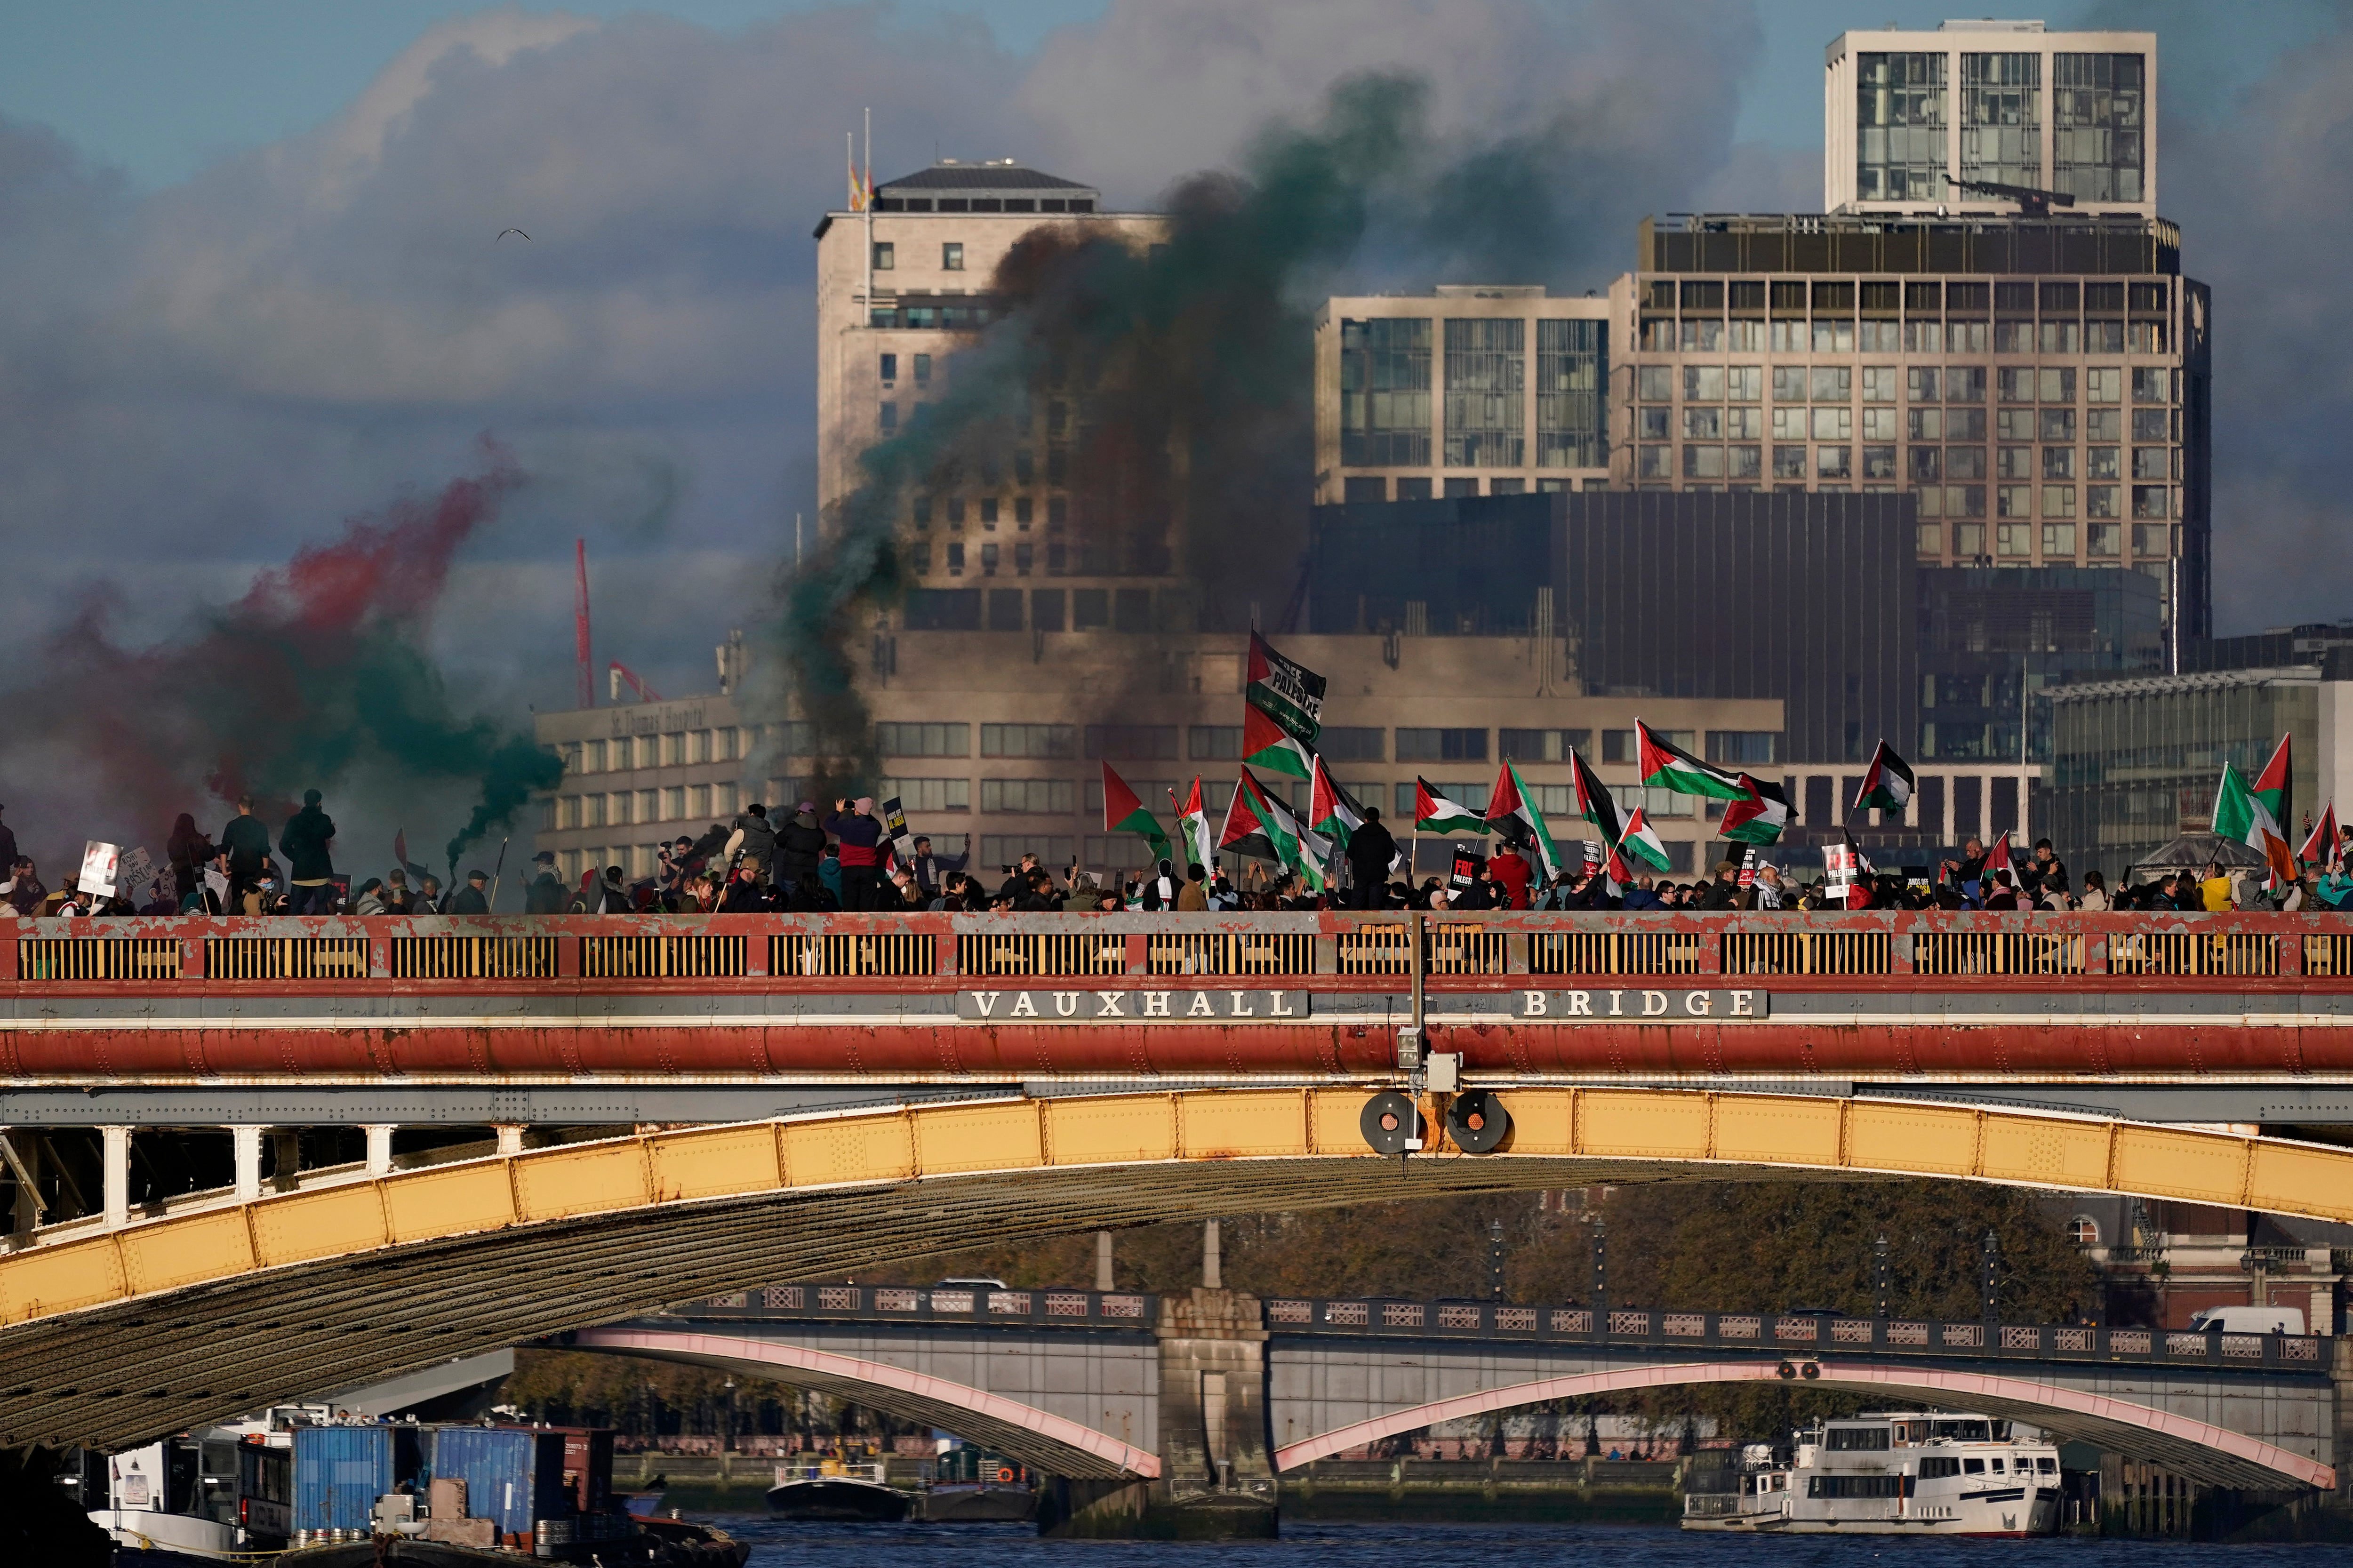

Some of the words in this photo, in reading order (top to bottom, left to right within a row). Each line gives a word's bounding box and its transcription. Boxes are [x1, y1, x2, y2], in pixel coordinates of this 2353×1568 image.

[1585, 846, 1600, 855] FREEDOM
[1827, 852, 1857, 870] FREE
[85, 864, 115, 878] PALESTIN
[1455, 859, 1474, 878] FRE
[1828, 868, 1857, 879] PALETINE
[1453, 874, 1473, 885] PALESTI
[971, 991, 1293, 1017] VAUXHALL
[1523, 991, 1753, 1016] BRIDGE
